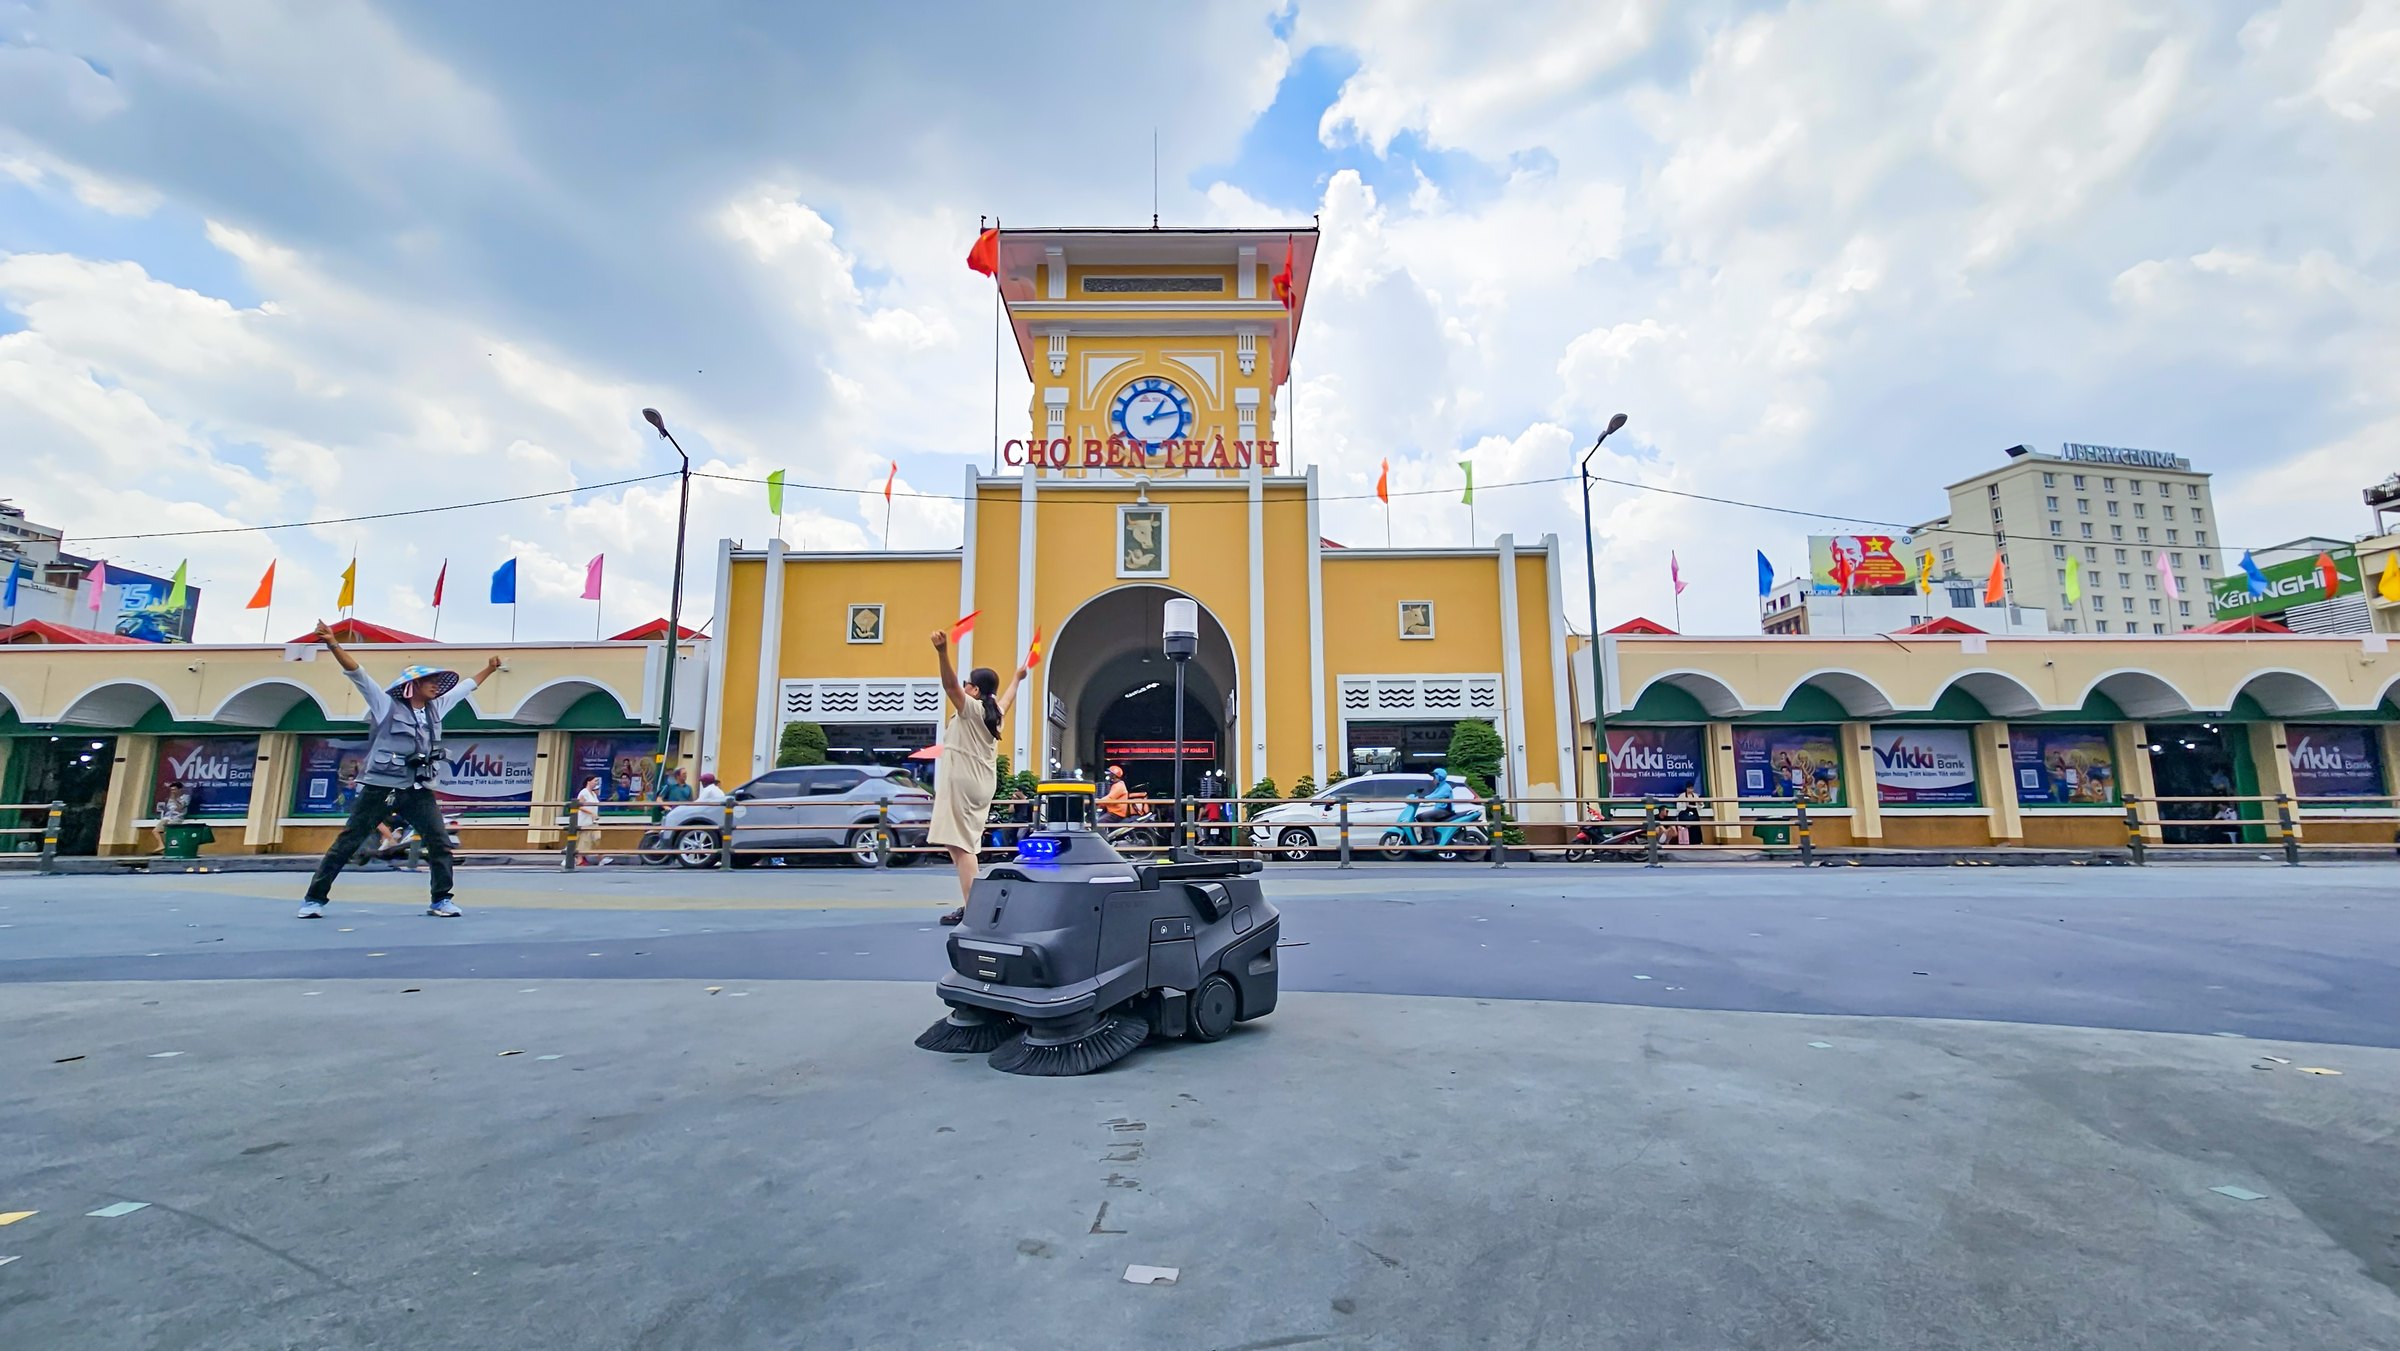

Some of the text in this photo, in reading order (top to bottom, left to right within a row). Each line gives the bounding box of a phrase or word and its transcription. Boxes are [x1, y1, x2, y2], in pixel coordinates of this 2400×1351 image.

[1003, 431, 1280, 470] CHỢ BẾN THÀNH
[2061, 442, 2182, 469] LIBERTY CENTRAL
[168, 745, 229, 779] Vikki
[446, 743, 504, 777] Vikki
[1606, 736, 1664, 770] Vikki
[1666, 760, 1694, 770] Bank
[1873, 736, 1934, 769] Vikki
[1937, 760, 1965, 769] Bank
[2287, 736, 2342, 769] Vikki
[229, 770, 254, 779] Ban
[505, 767, 533, 777] Bank
